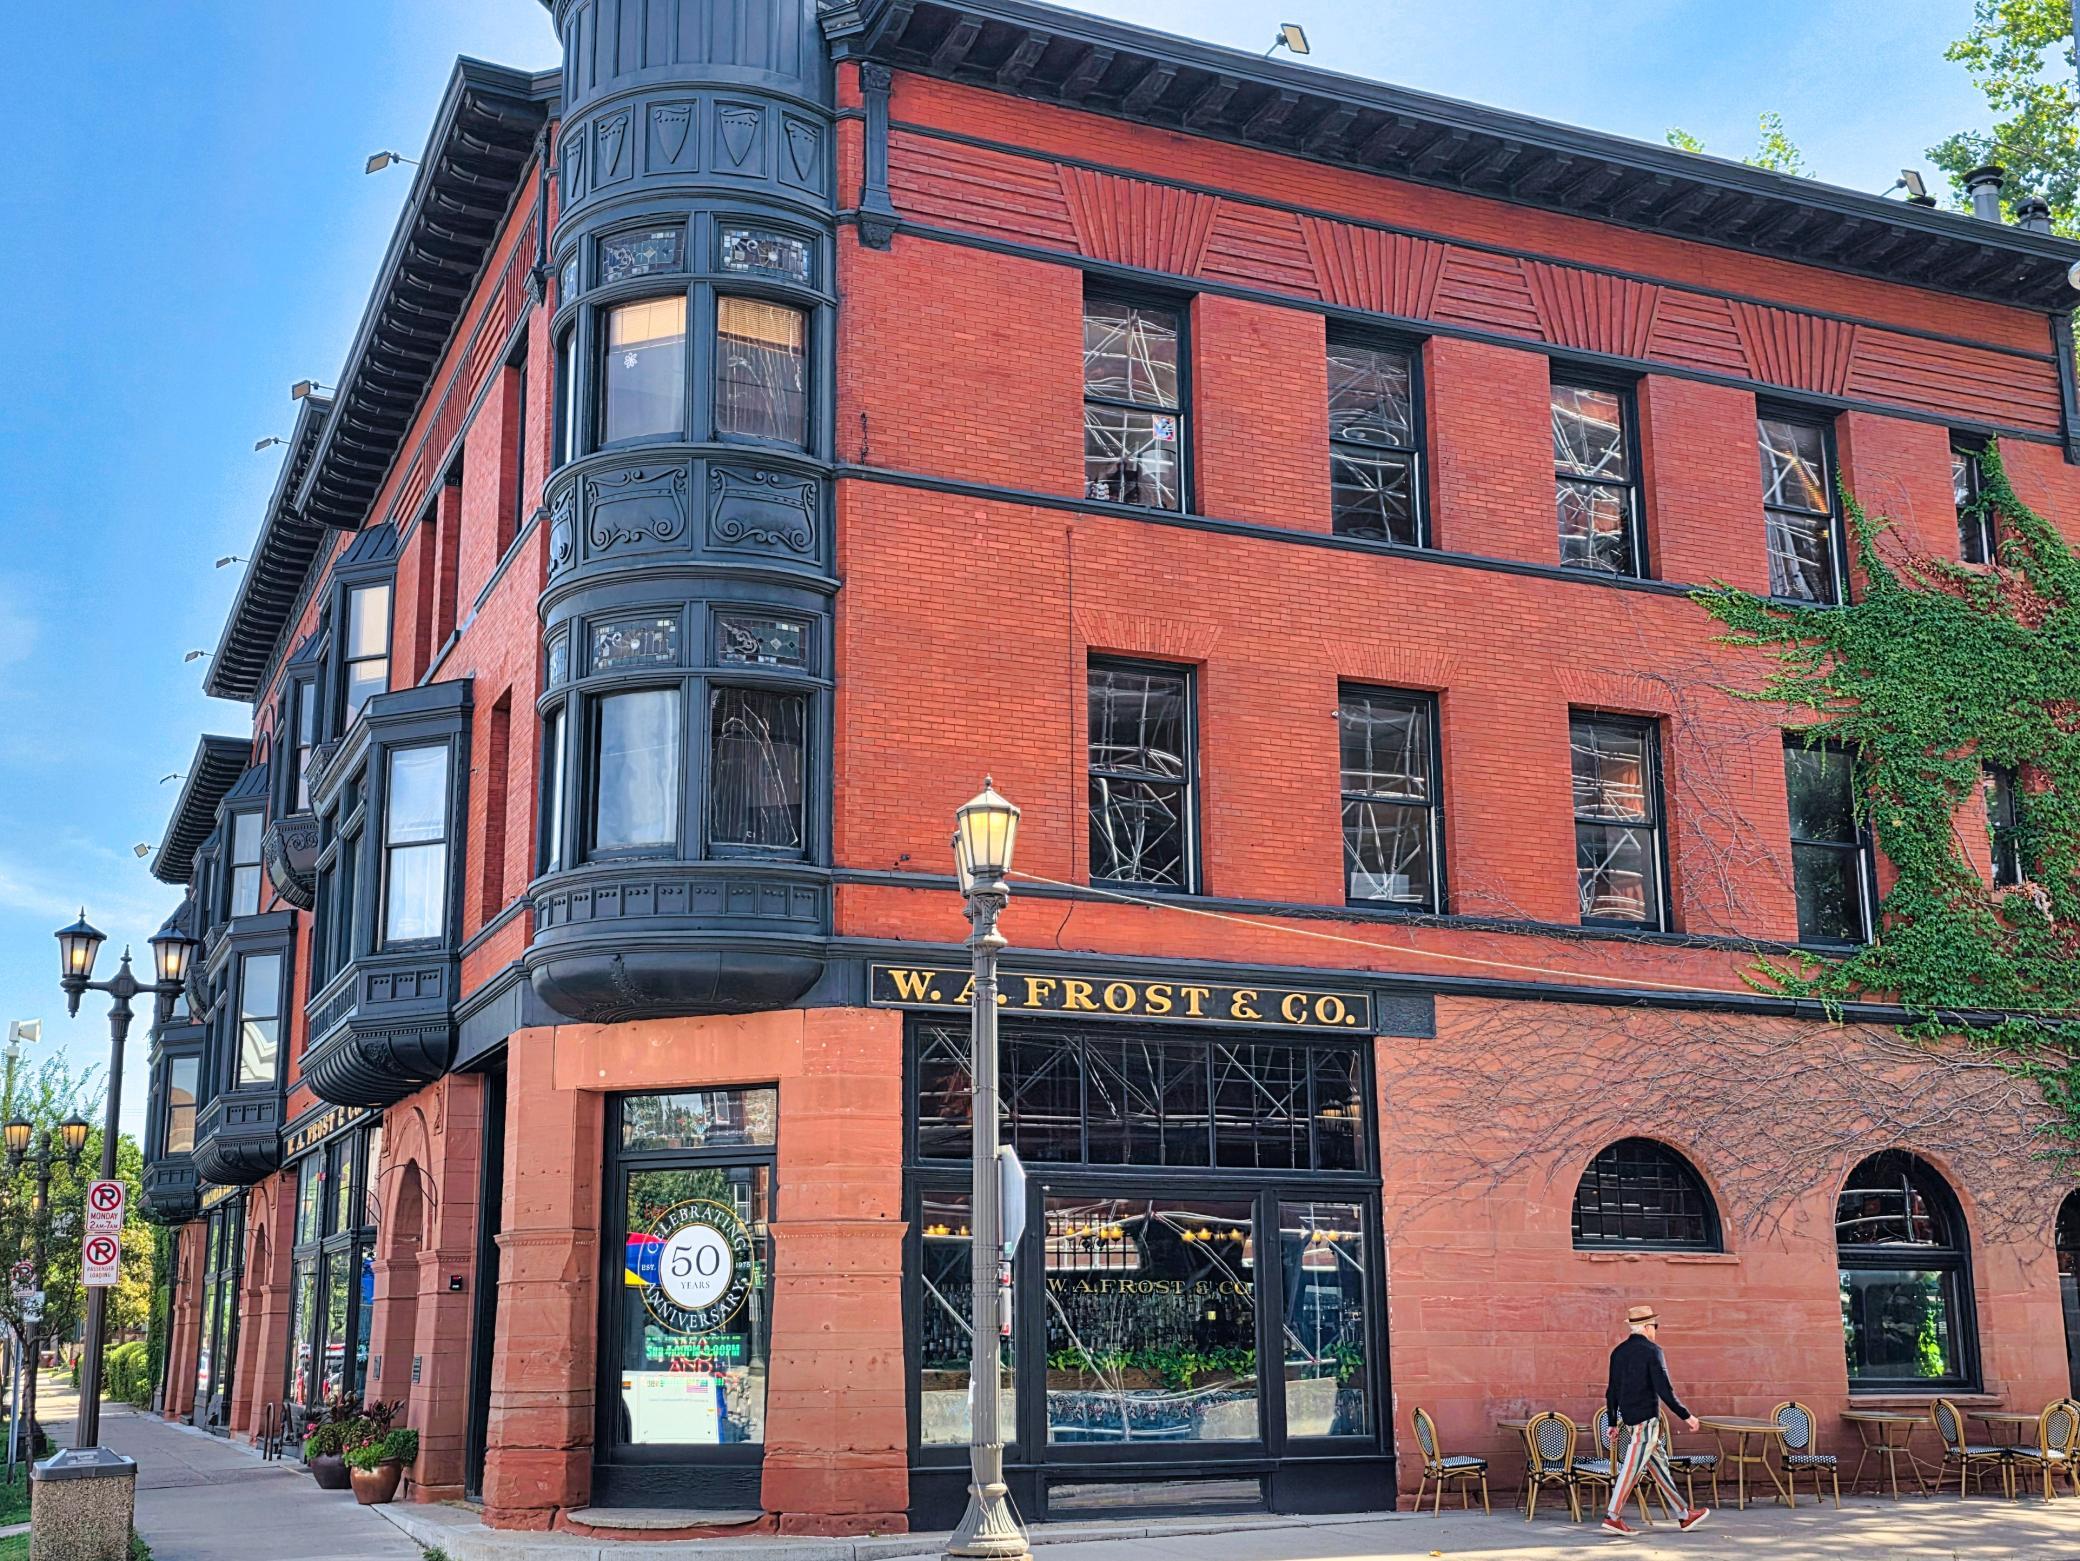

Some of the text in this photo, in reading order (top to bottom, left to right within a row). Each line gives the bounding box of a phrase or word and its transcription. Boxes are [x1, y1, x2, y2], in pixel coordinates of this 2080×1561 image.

[888, 970, 941, 1001] W.
[1023, 977, 1210, 1016] FROST
[1230, 990, 1263, 1019] &
[1281, 993, 1356, 1025] CO.
[90, 1212, 119, 1220] MONDAY
[647, 1205, 747, 1254] CELEBRATING
[671, 1245, 720, 1277] 50
[680, 1281, 711, 1289] YEARS
[1047, 1279, 1068, 1292] W.
[1100, 1279, 1185, 1295] FROST
[647, 1278, 745, 1328] ANNIVERSARY
